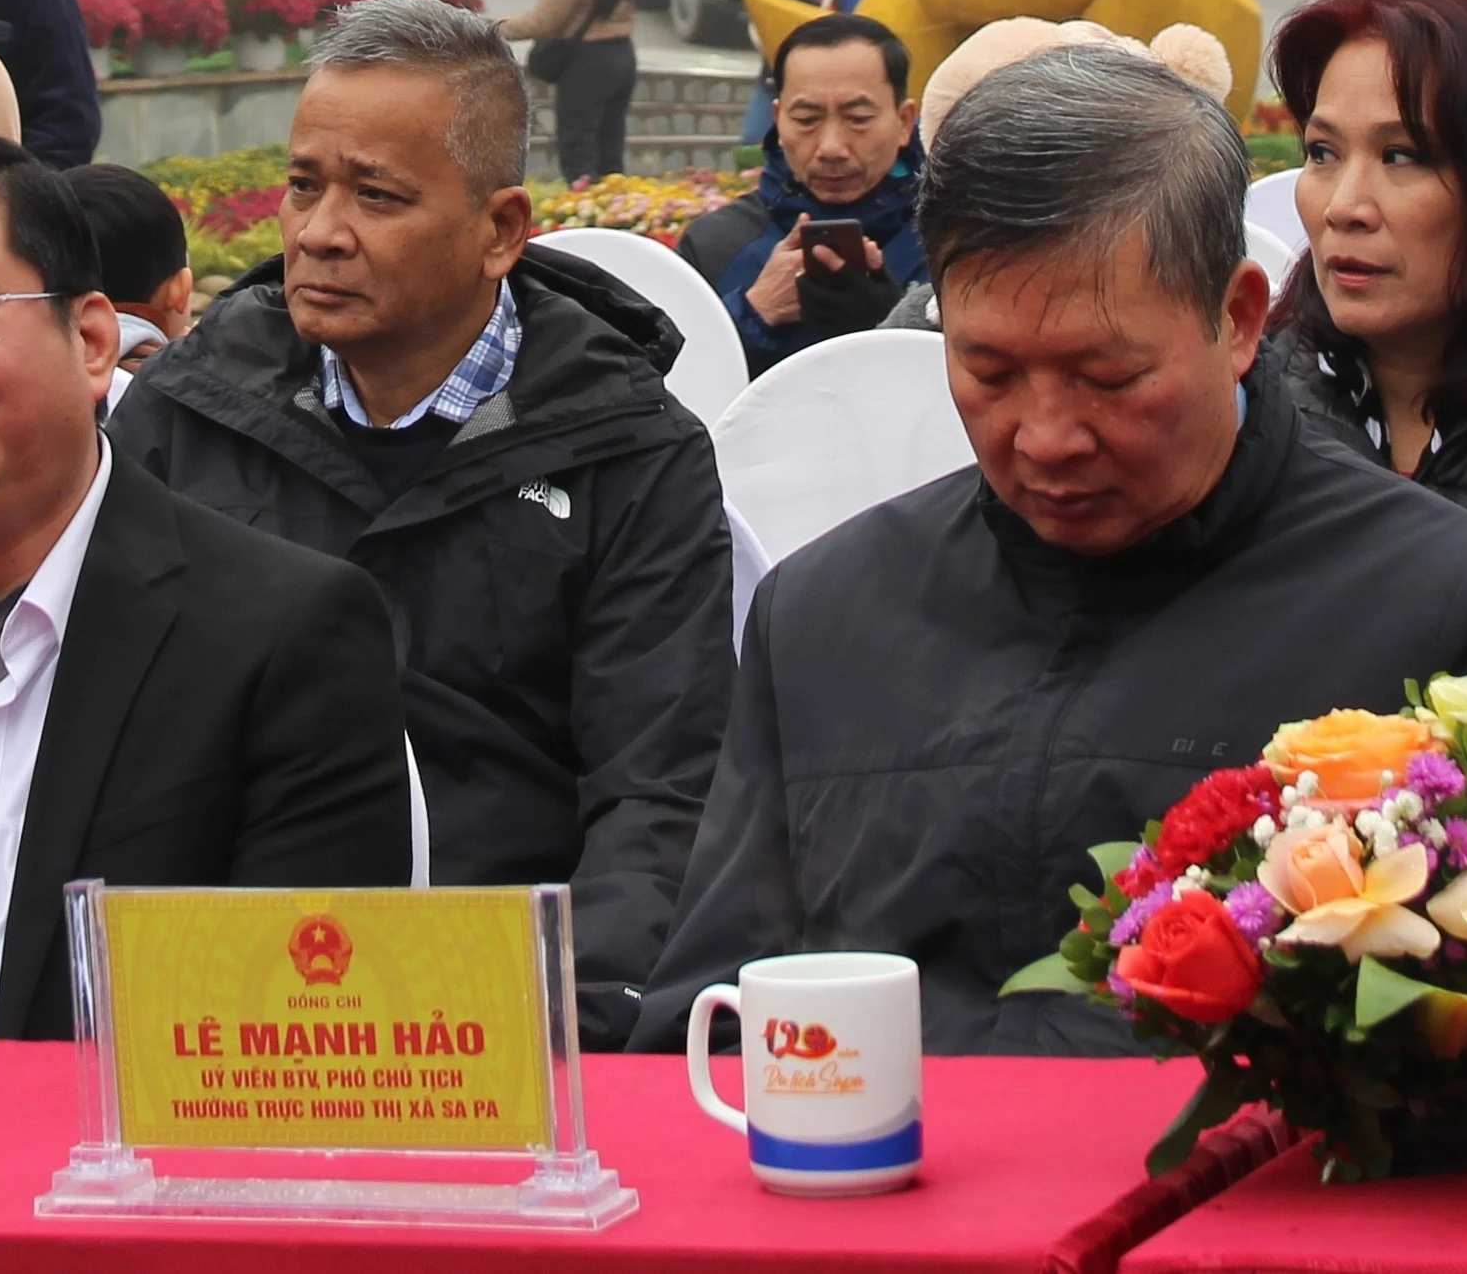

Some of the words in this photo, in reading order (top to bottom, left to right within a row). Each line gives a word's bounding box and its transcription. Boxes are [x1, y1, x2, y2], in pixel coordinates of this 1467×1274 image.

[336, 994, 362, 1009] CHÍ
[173, 1015, 224, 1057] LÊ
[239, 1021, 378, 1064] MẠNH
[392, 1009, 486, 1057] HẢO
[761, 1017, 837, 1060] 120
[232, 1067, 277, 1088] VIÊN
[283, 1069, 321, 1090] BTV,
[326, 1065, 366, 1088] PHÓ
[372, 1063, 412, 1088] CHỦ
[419, 1069, 463, 1093] TỊCH
[171, 1096, 249, 1119] THƯỜNG
[255, 1098, 304, 1123] TRỰC
[372, 1099, 402, 1122] THỊ
[409, 1096, 435, 1119] XÃ
[442, 1100, 467, 1119] SA
[473, 1100, 499, 1119] PA
